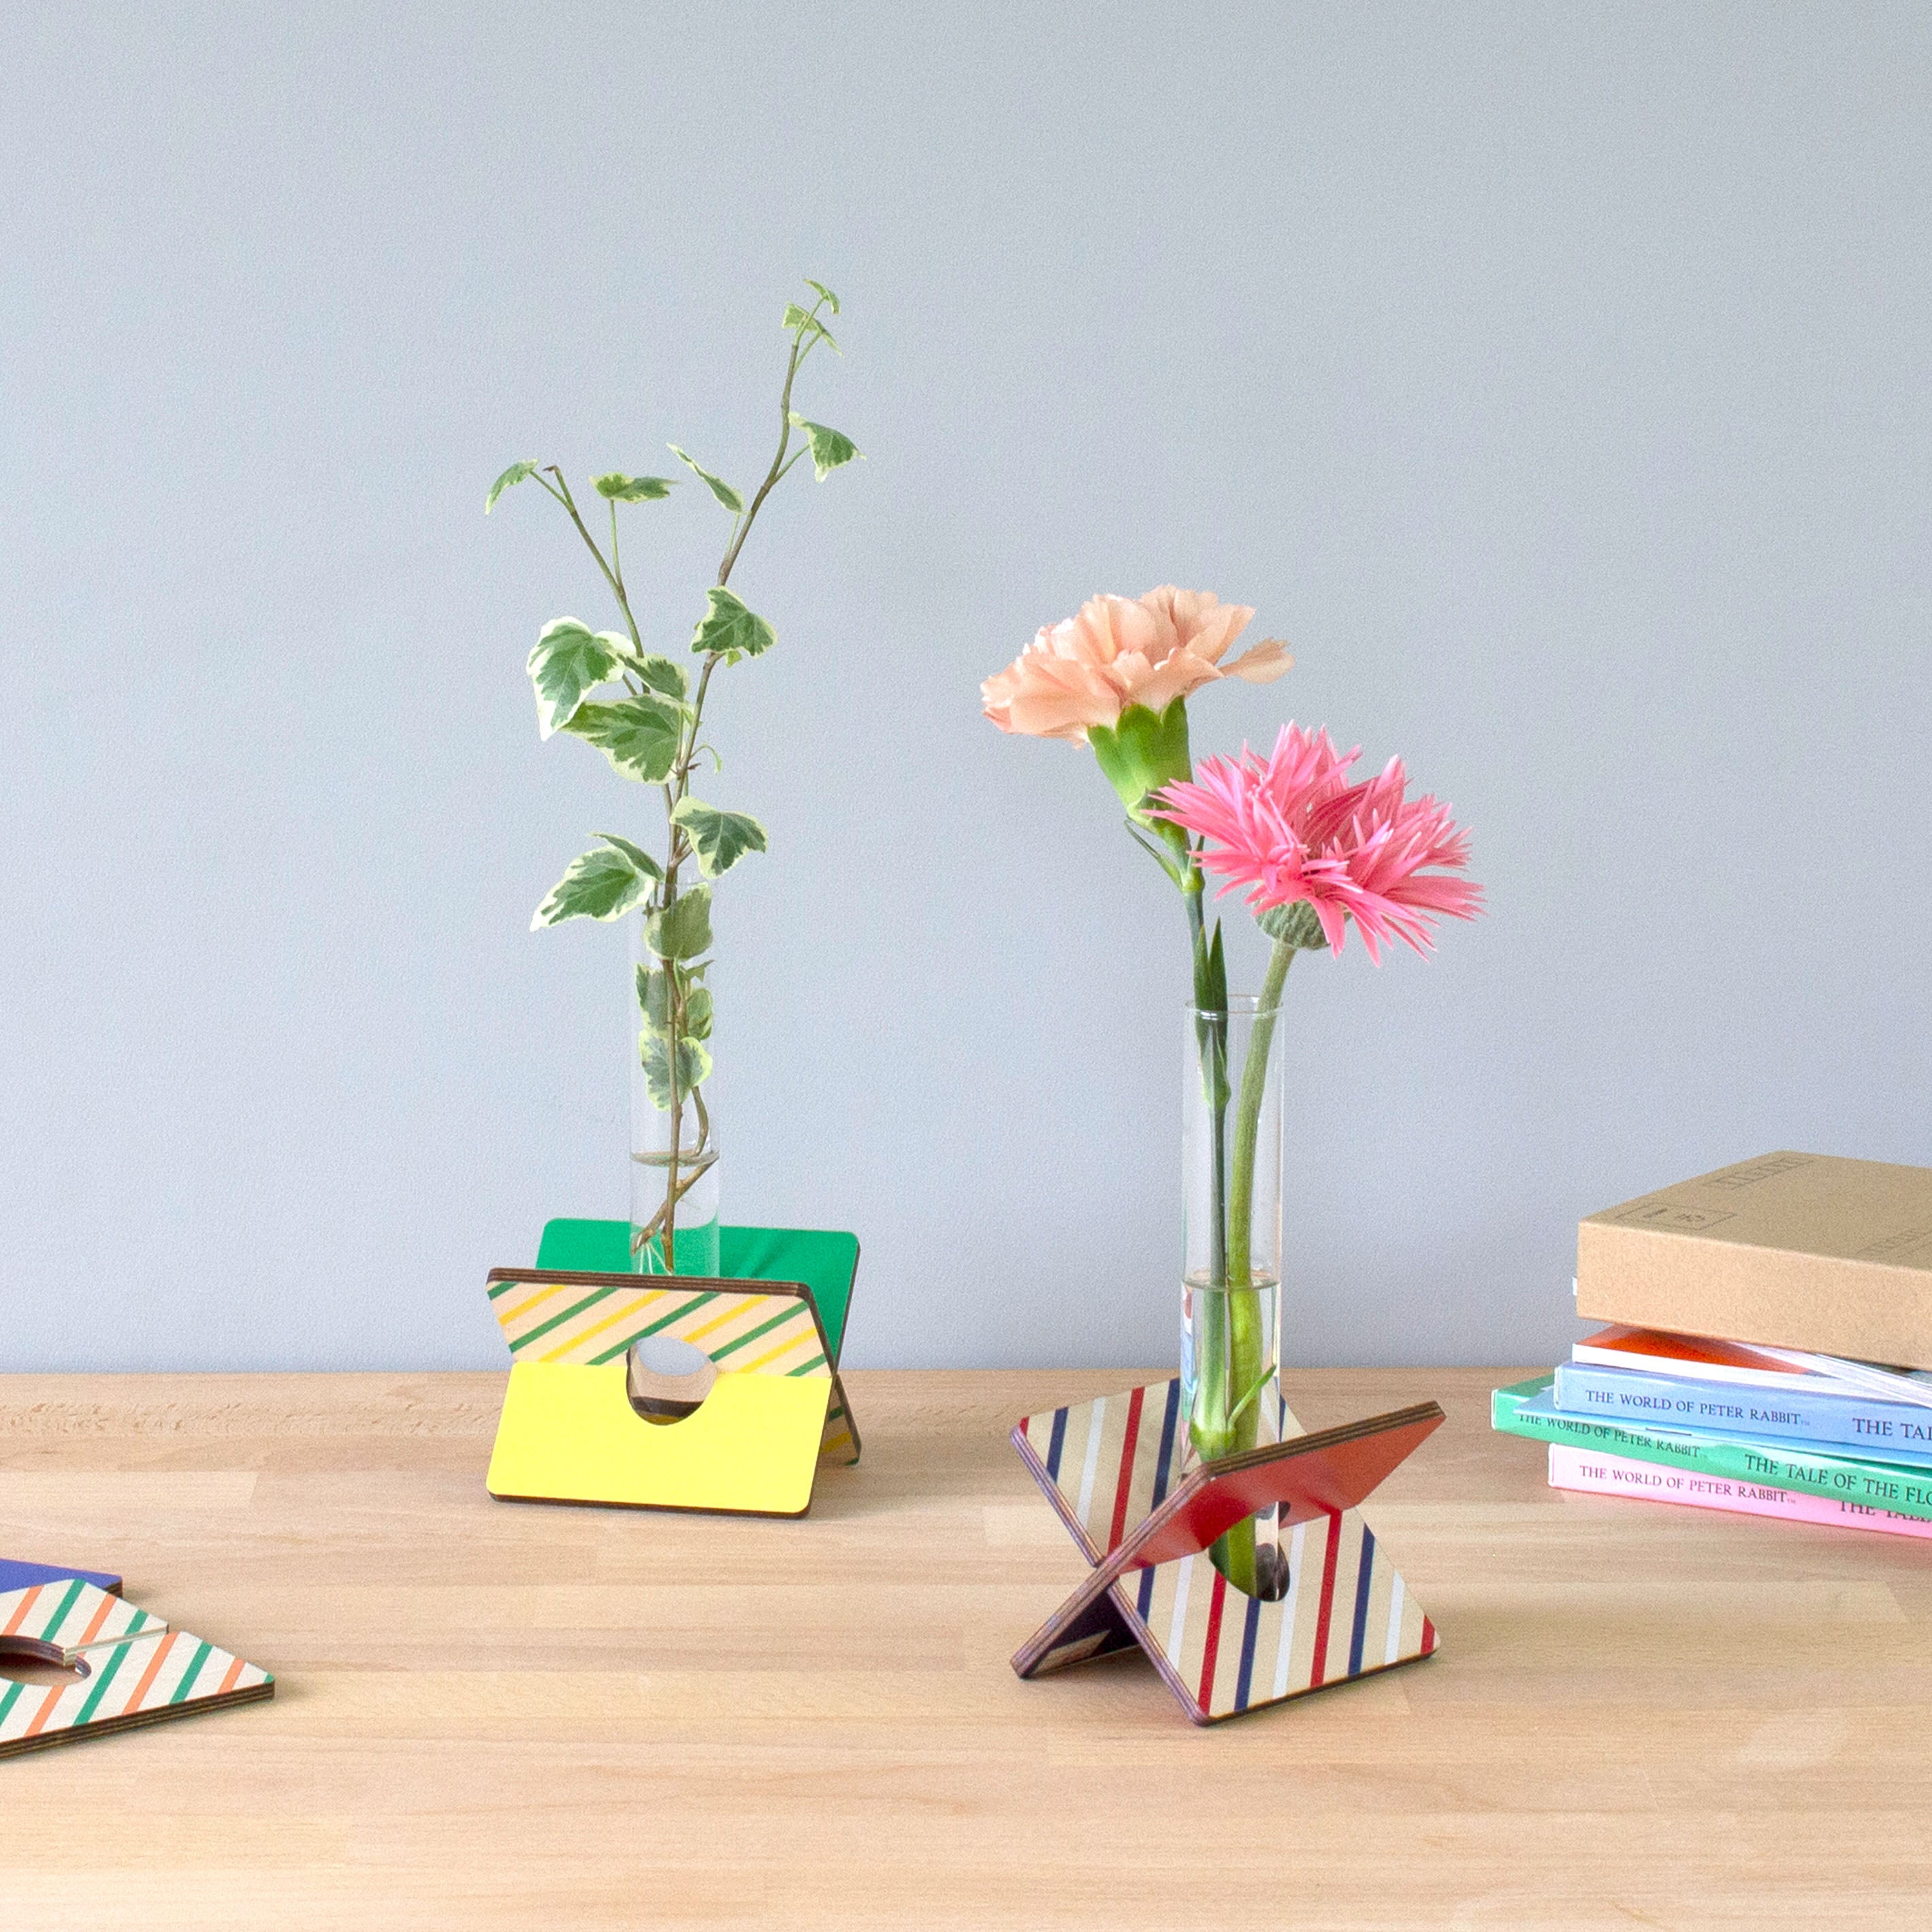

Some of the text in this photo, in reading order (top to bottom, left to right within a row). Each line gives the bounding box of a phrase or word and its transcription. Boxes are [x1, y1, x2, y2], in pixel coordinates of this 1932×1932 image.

[1585, 1389, 1614, 1404] THE
[1620, 1394, 1671, 1410] WORLD
[1676, 1400, 1694, 1413] OF
[1700, 1403, 1743, 1419] PETER
[1520, 1414, 1542, 1425] THE
[1547, 1417, 1590, 1435] WORLD
[1594, 1428, 1610, 1438] OF
[1614, 1430, 1652, 1448] PETER
[1852, 1417, 1893, 1436] THE
[1579, 1465, 1607, 1479] THE
[1613, 1470, 1662, 1487] WORLD
[1667, 1477, 1684, 1489] OF
[1690, 1479, 1732, 1496] PETER
[1745, 1454, 1778, 1475] THE
[1786, 1464, 1828, 1484] TALE
[1833, 1473, 1857, 1490] OF
[1863, 1478, 1899, 1499] THE
